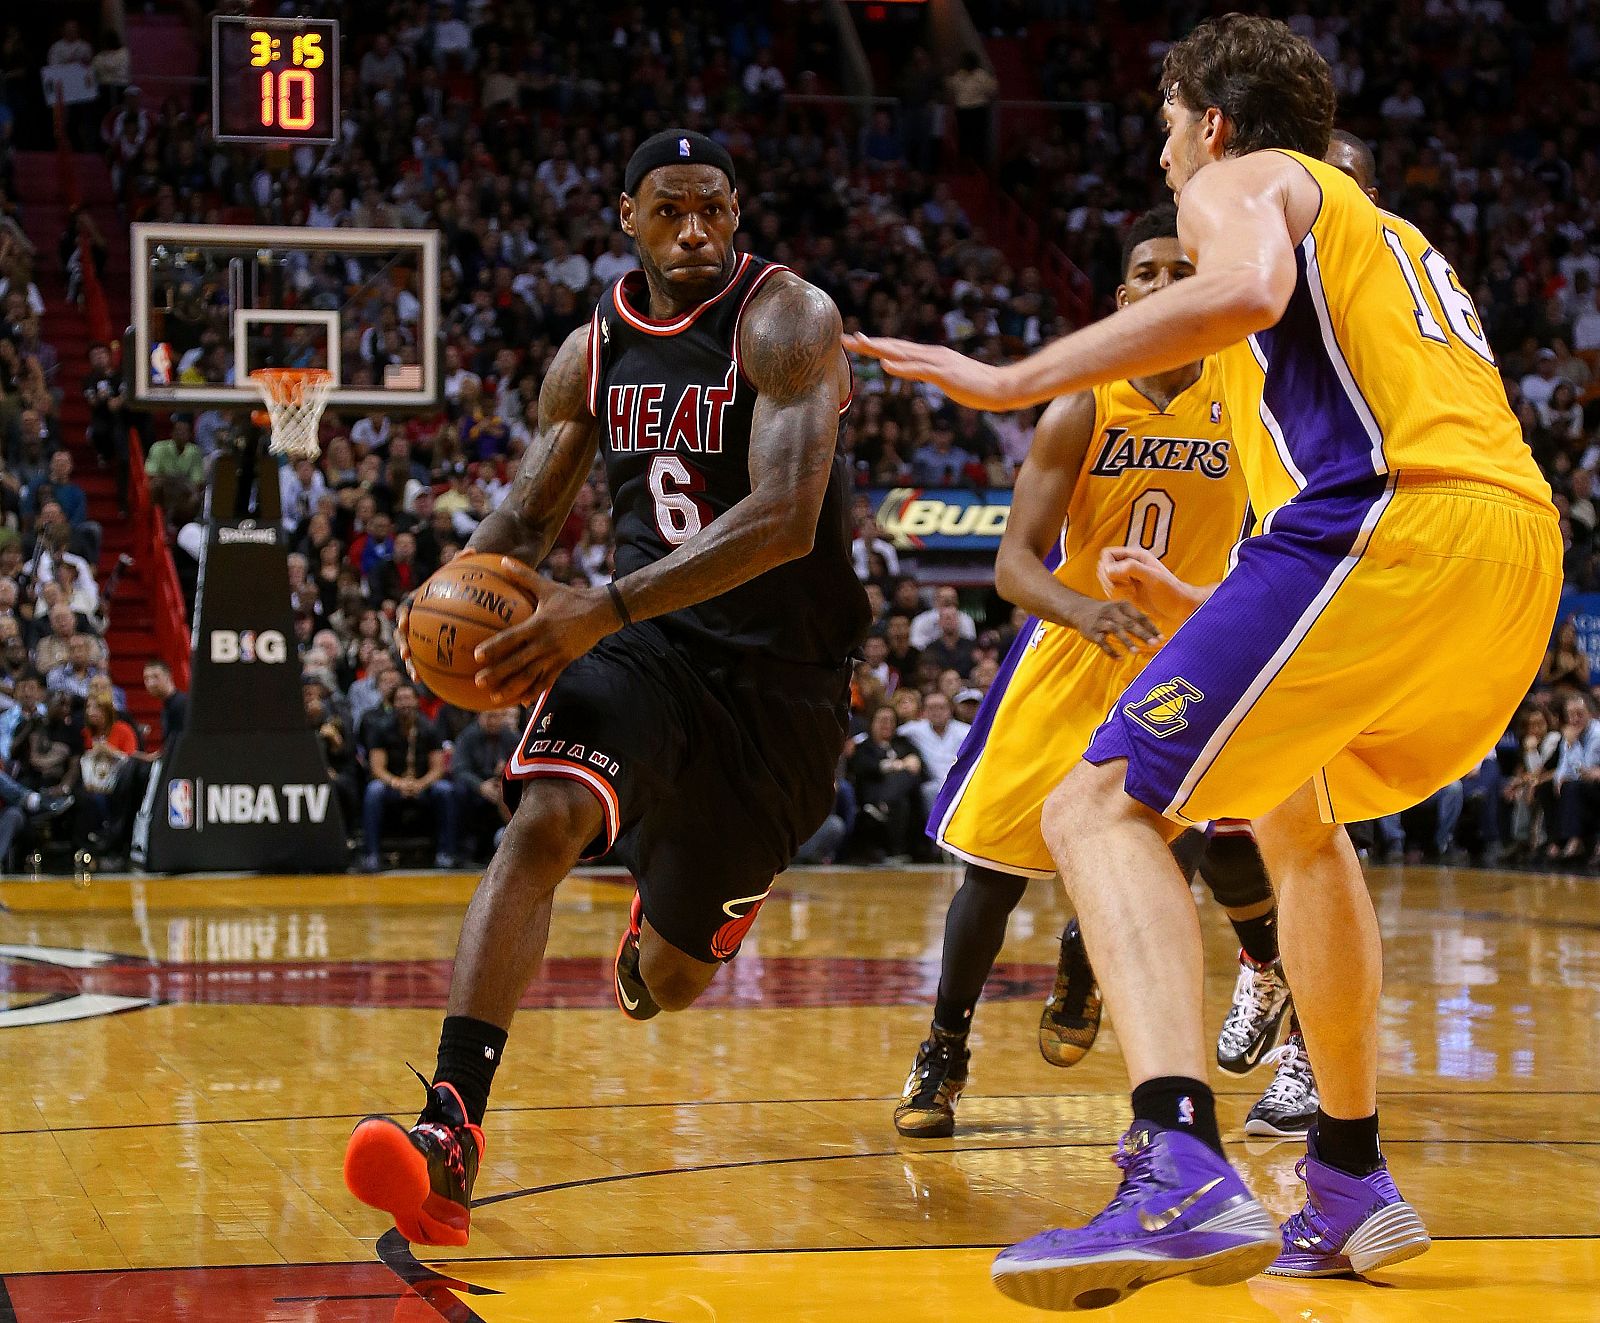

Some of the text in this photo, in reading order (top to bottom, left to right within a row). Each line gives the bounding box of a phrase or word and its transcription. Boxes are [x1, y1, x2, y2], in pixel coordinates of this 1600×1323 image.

[261, 70, 315, 131] 10
[1381, 224, 1497, 368] 16
[607, 361, 738, 453] HEAT
[1089, 427, 1232, 480] LAKERS
[648, 453, 707, 546] 6
[1124, 487, 1176, 561] 0
[529, 740, 620, 776] MIAMI
[207, 783, 331, 824] NBA TV
